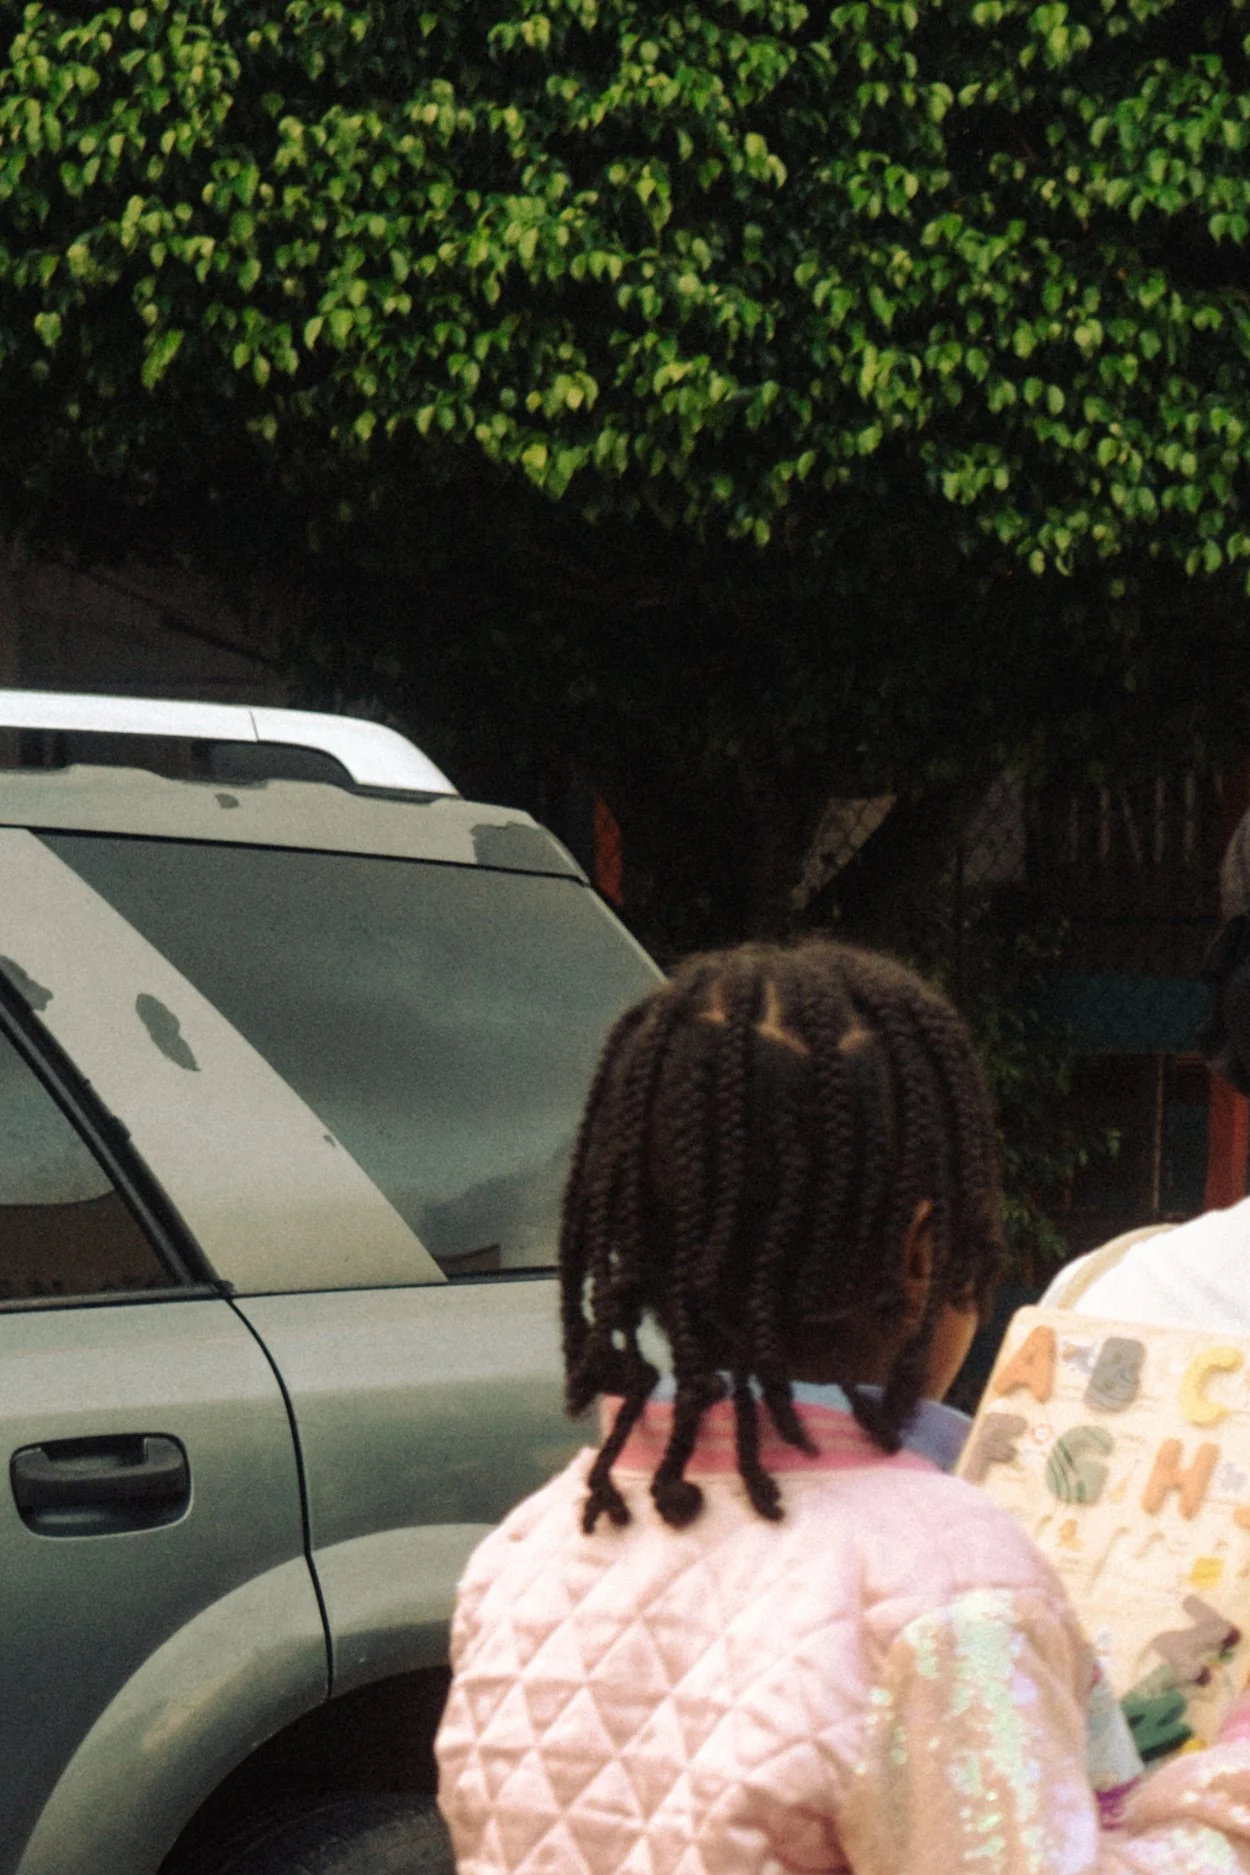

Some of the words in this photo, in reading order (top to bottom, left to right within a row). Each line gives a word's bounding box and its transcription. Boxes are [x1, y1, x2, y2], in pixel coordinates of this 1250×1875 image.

[993, 1325, 1057, 1404] A
[1083, 1336, 1147, 1414] B
[1177, 1346, 1245, 1429] C
[962, 1412, 1028, 1486] F
[1045, 1424, 1116, 1505] G
[1140, 1437, 1220, 1521] H
